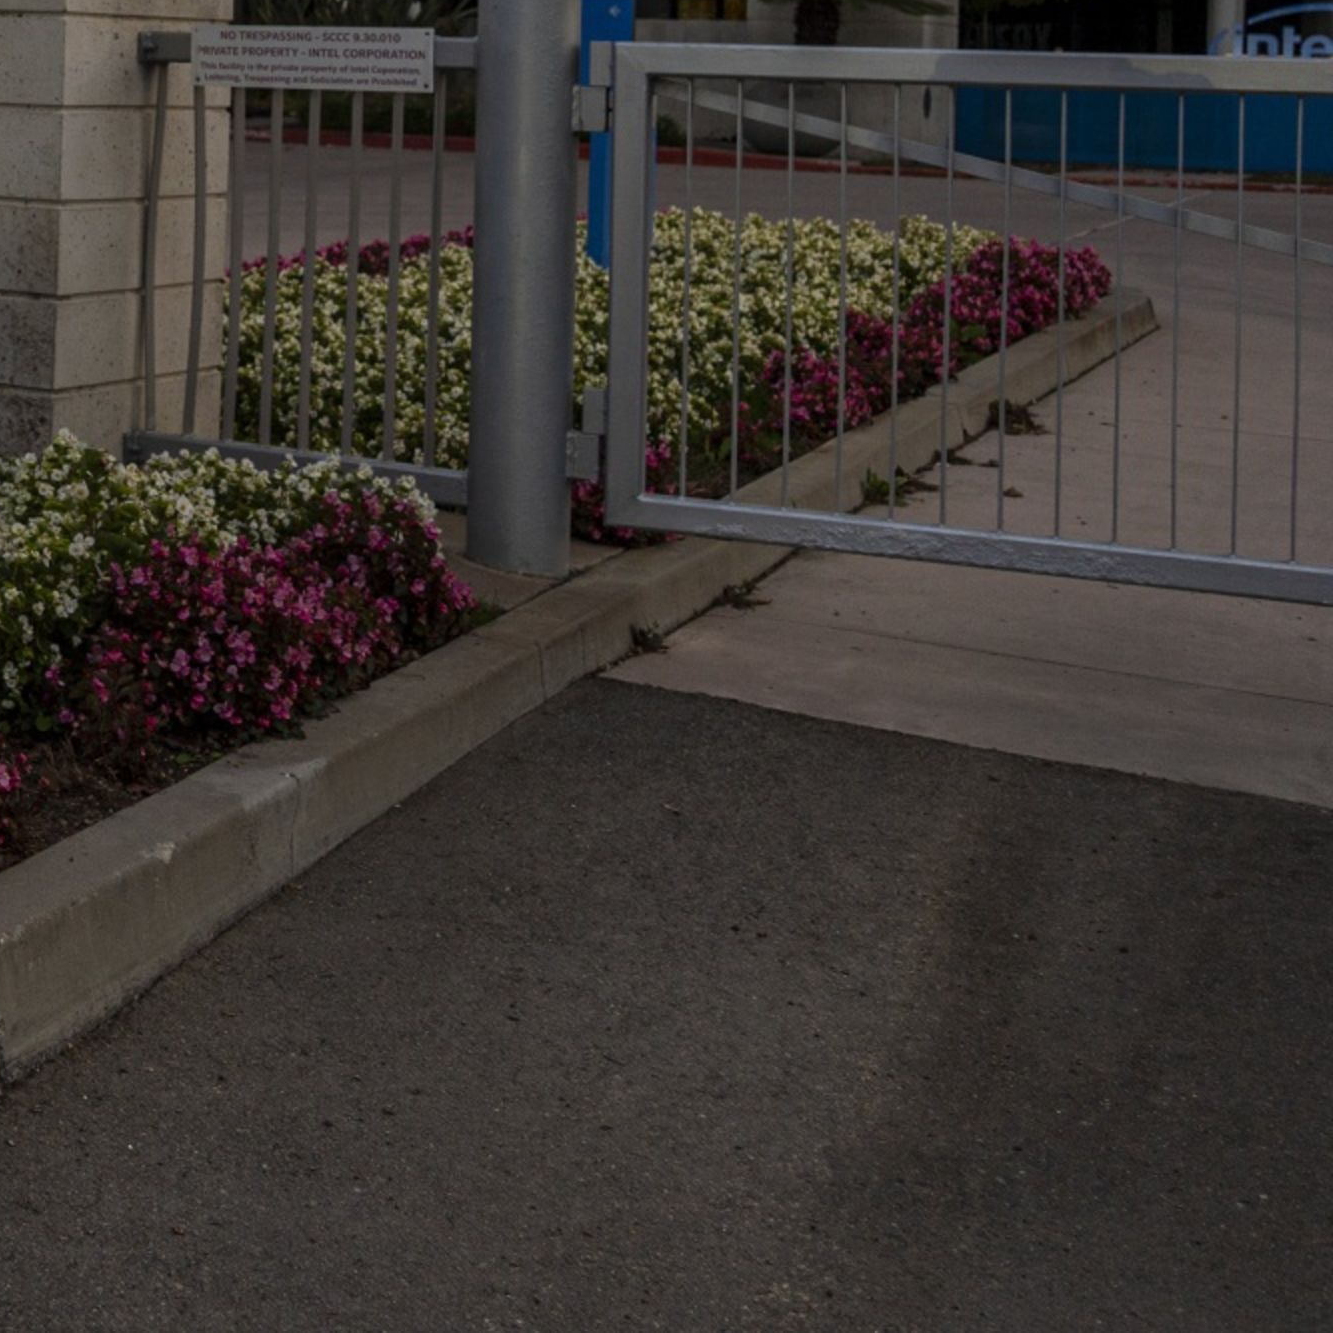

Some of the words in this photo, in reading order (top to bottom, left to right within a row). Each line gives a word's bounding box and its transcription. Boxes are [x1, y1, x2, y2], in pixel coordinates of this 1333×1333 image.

[220, 31, 237, 40] NO
[240, 31, 312, 41] TRESPASSING
[322, 32, 350, 42] SCCC
[353, 33, 401, 43] 9.30.010
[197, 46, 238, 56] PRIVATE
[242, 47, 298, 57] PROPERTY
[309, 48, 340, 58] INTEL
[343, 49, 426, 59] CORPORATION
[201, 61, 217, 69] This
[219, 62, 245, 71] facility
[271, 64, 299, 73] private
[301, 65, 337, 74] property
[339, 65, 348, 73] of
[351, 65, 369, 73] Intel
[245, 73, 290, 84] Trespassing
